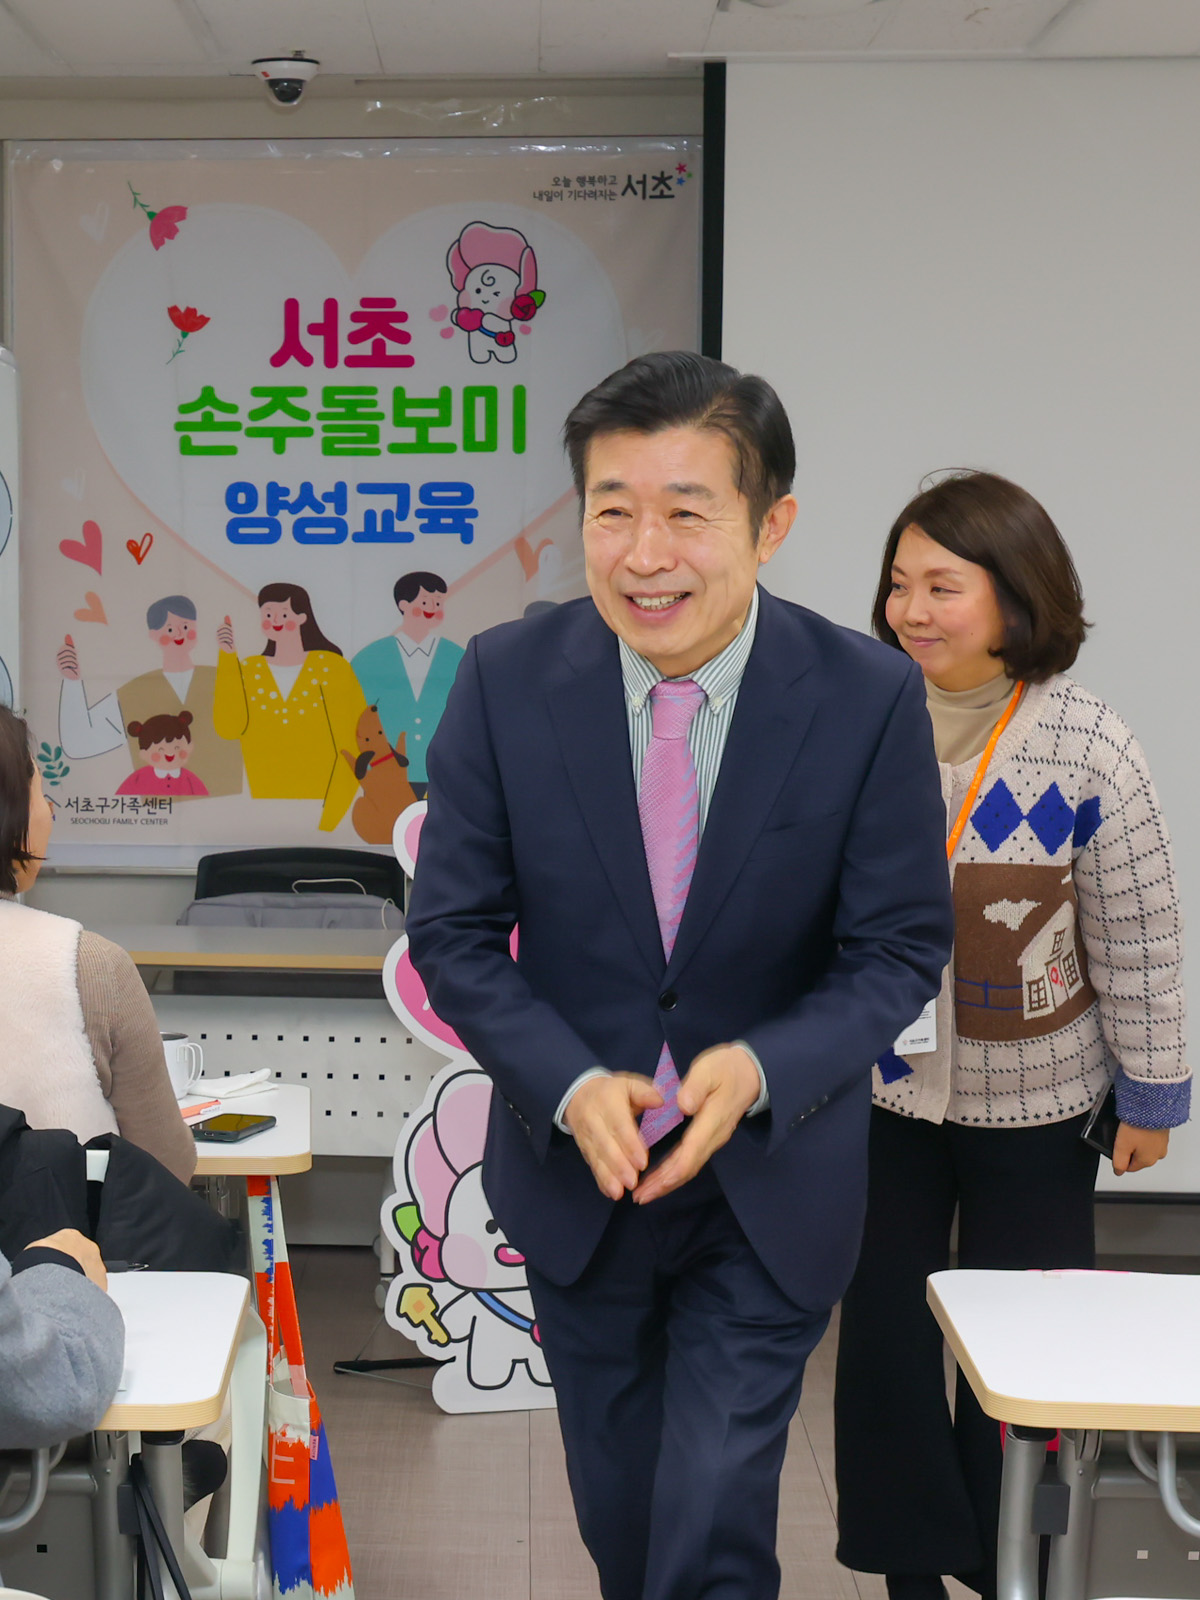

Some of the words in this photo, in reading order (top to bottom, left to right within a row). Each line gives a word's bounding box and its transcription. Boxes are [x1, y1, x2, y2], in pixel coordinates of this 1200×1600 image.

[551, 175, 572, 188] 오늘
[576, 175, 618, 187] 행복하고
[621, 170, 675, 200] 서초
[532, 189, 563, 202] 내일이
[567, 189, 618, 201] 기다려지는
[269, 297, 415, 369] 서초
[173, 384, 527, 457] 손주돌보미
[224, 481, 479, 546] 양성교육
[64, 796, 173, 815] 서초구가족센터
[70, 817, 110, 825] SEOCHOGU
[112, 817, 138, 825] FAMILY
[140, 817, 169, 826] CENTER
